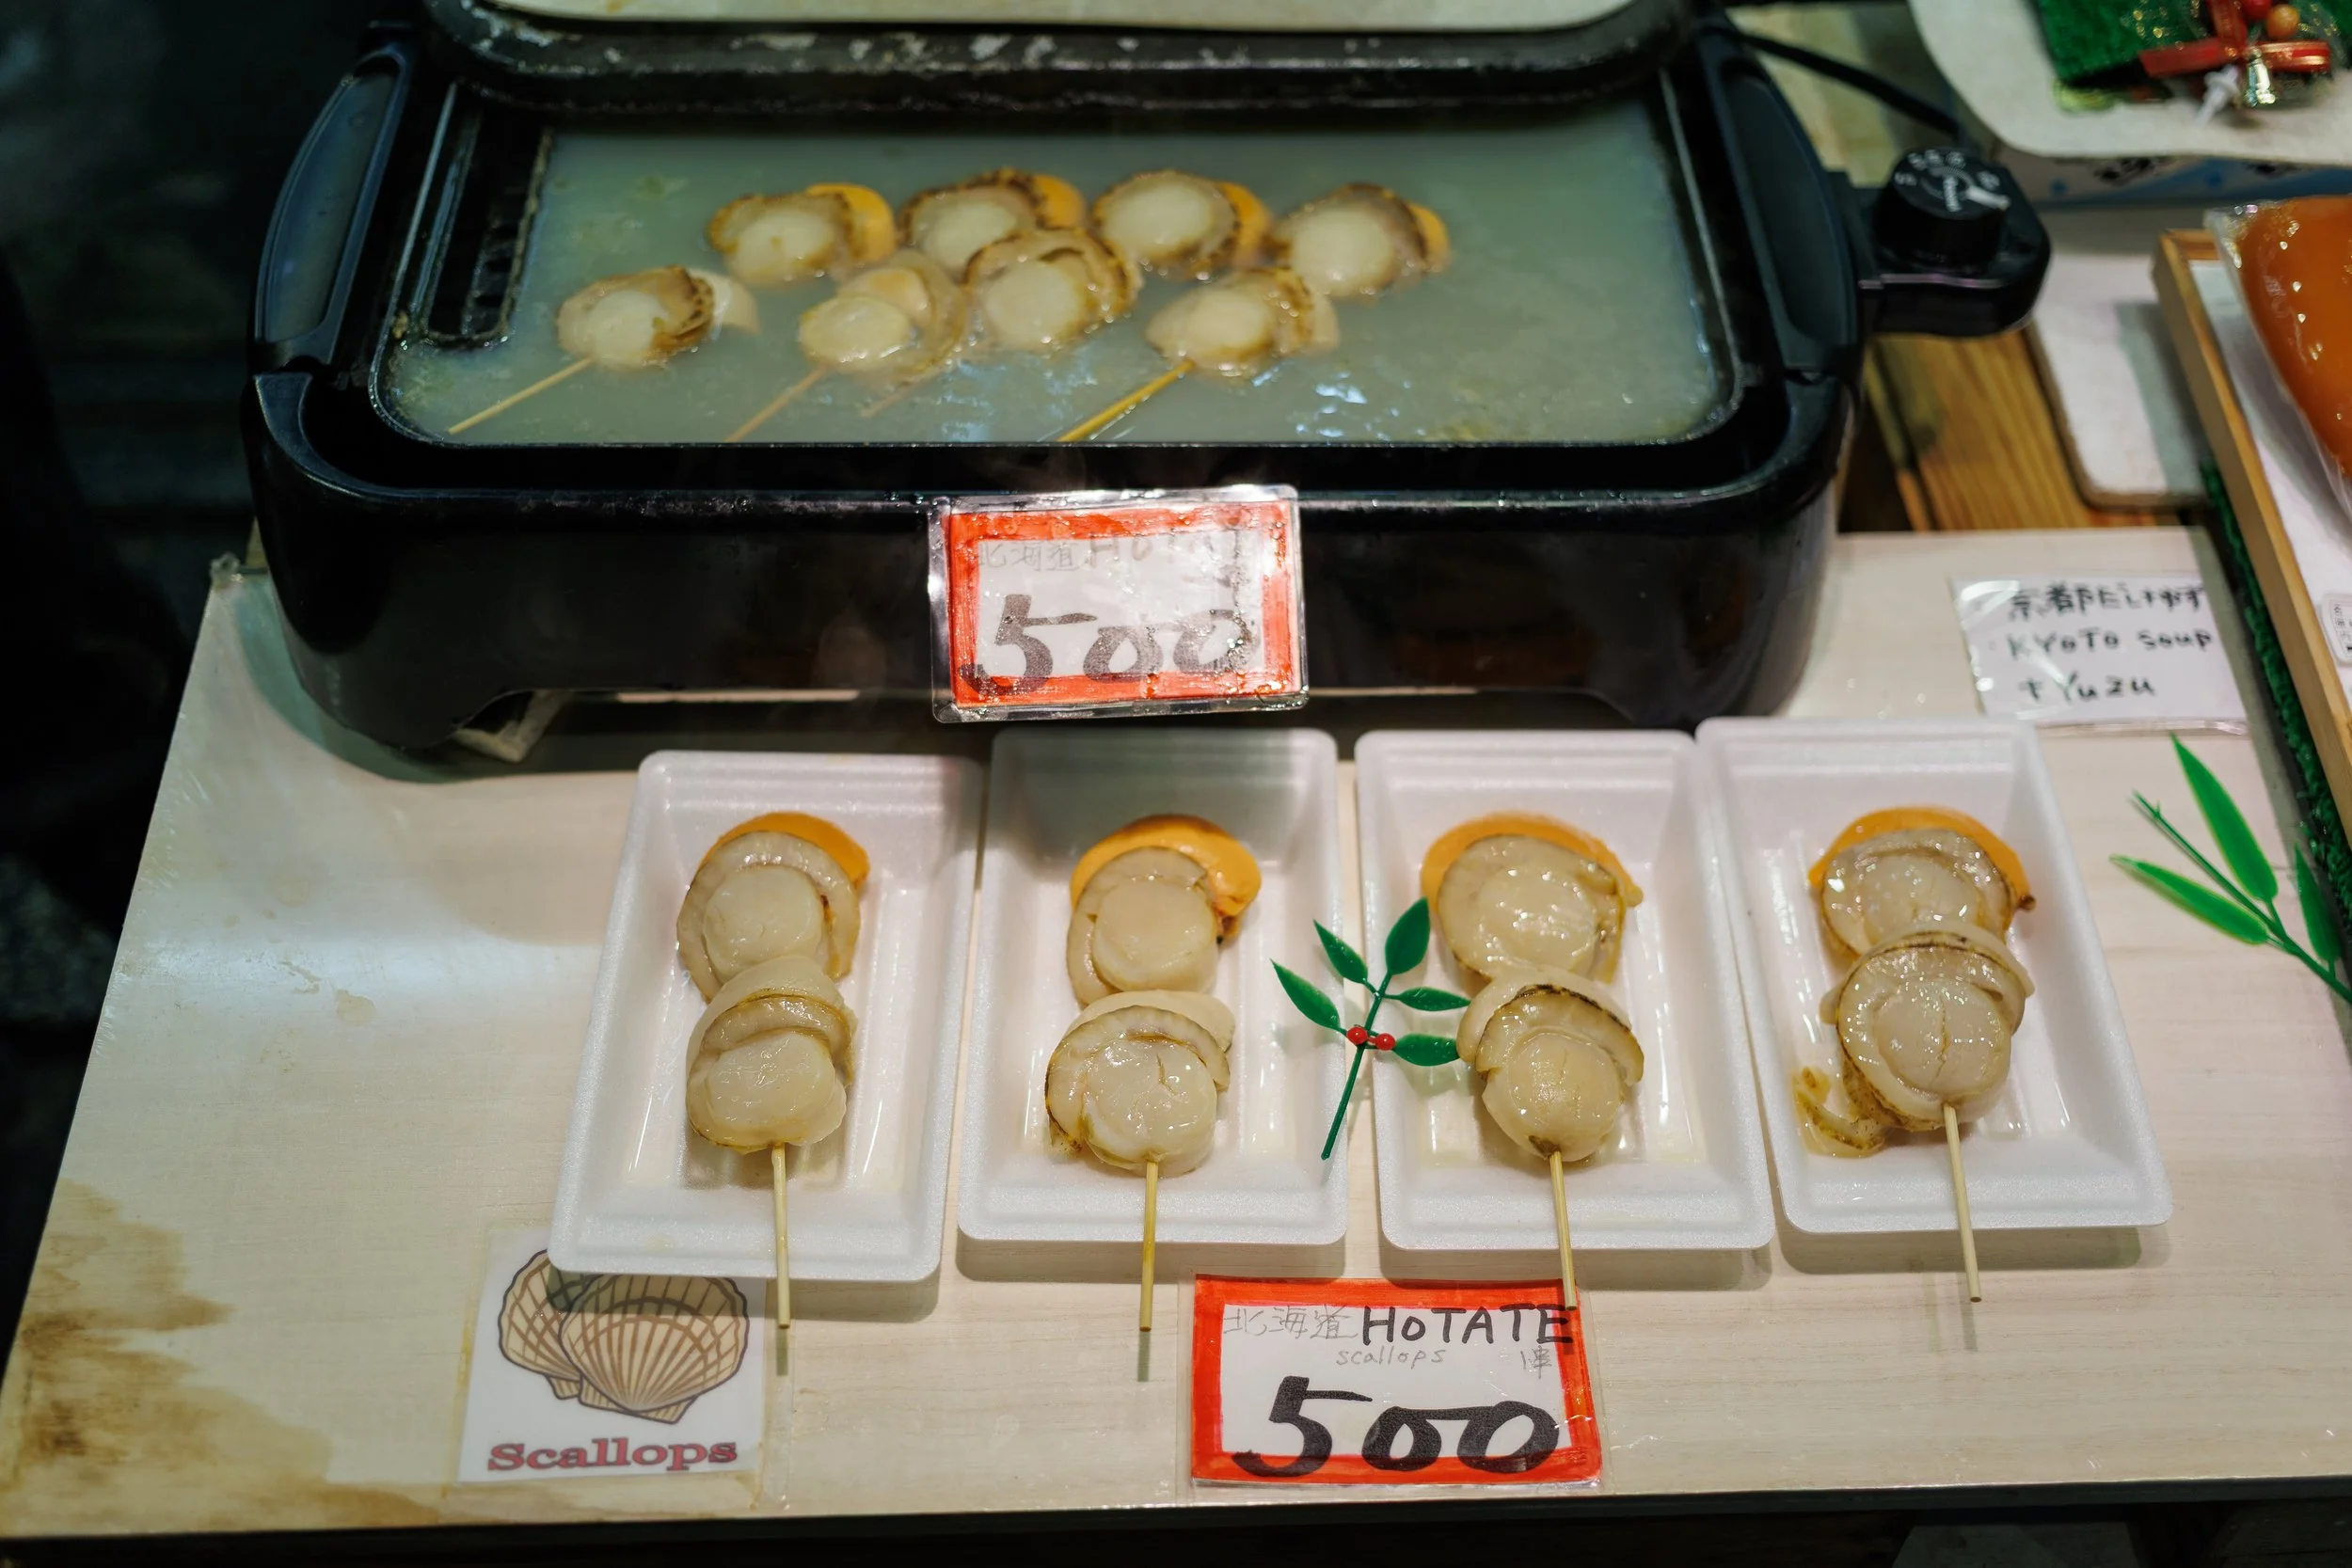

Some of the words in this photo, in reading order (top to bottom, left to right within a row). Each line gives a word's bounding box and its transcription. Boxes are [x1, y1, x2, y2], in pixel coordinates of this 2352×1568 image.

[959, 594, 1262, 697] 500
[1223, 1304, 1359, 1340] 北海道
[1336, 1345, 1447, 1370] scallops
[1231, 1375, 1562, 1479] 500
[486, 1436, 739, 1472] Scallops
